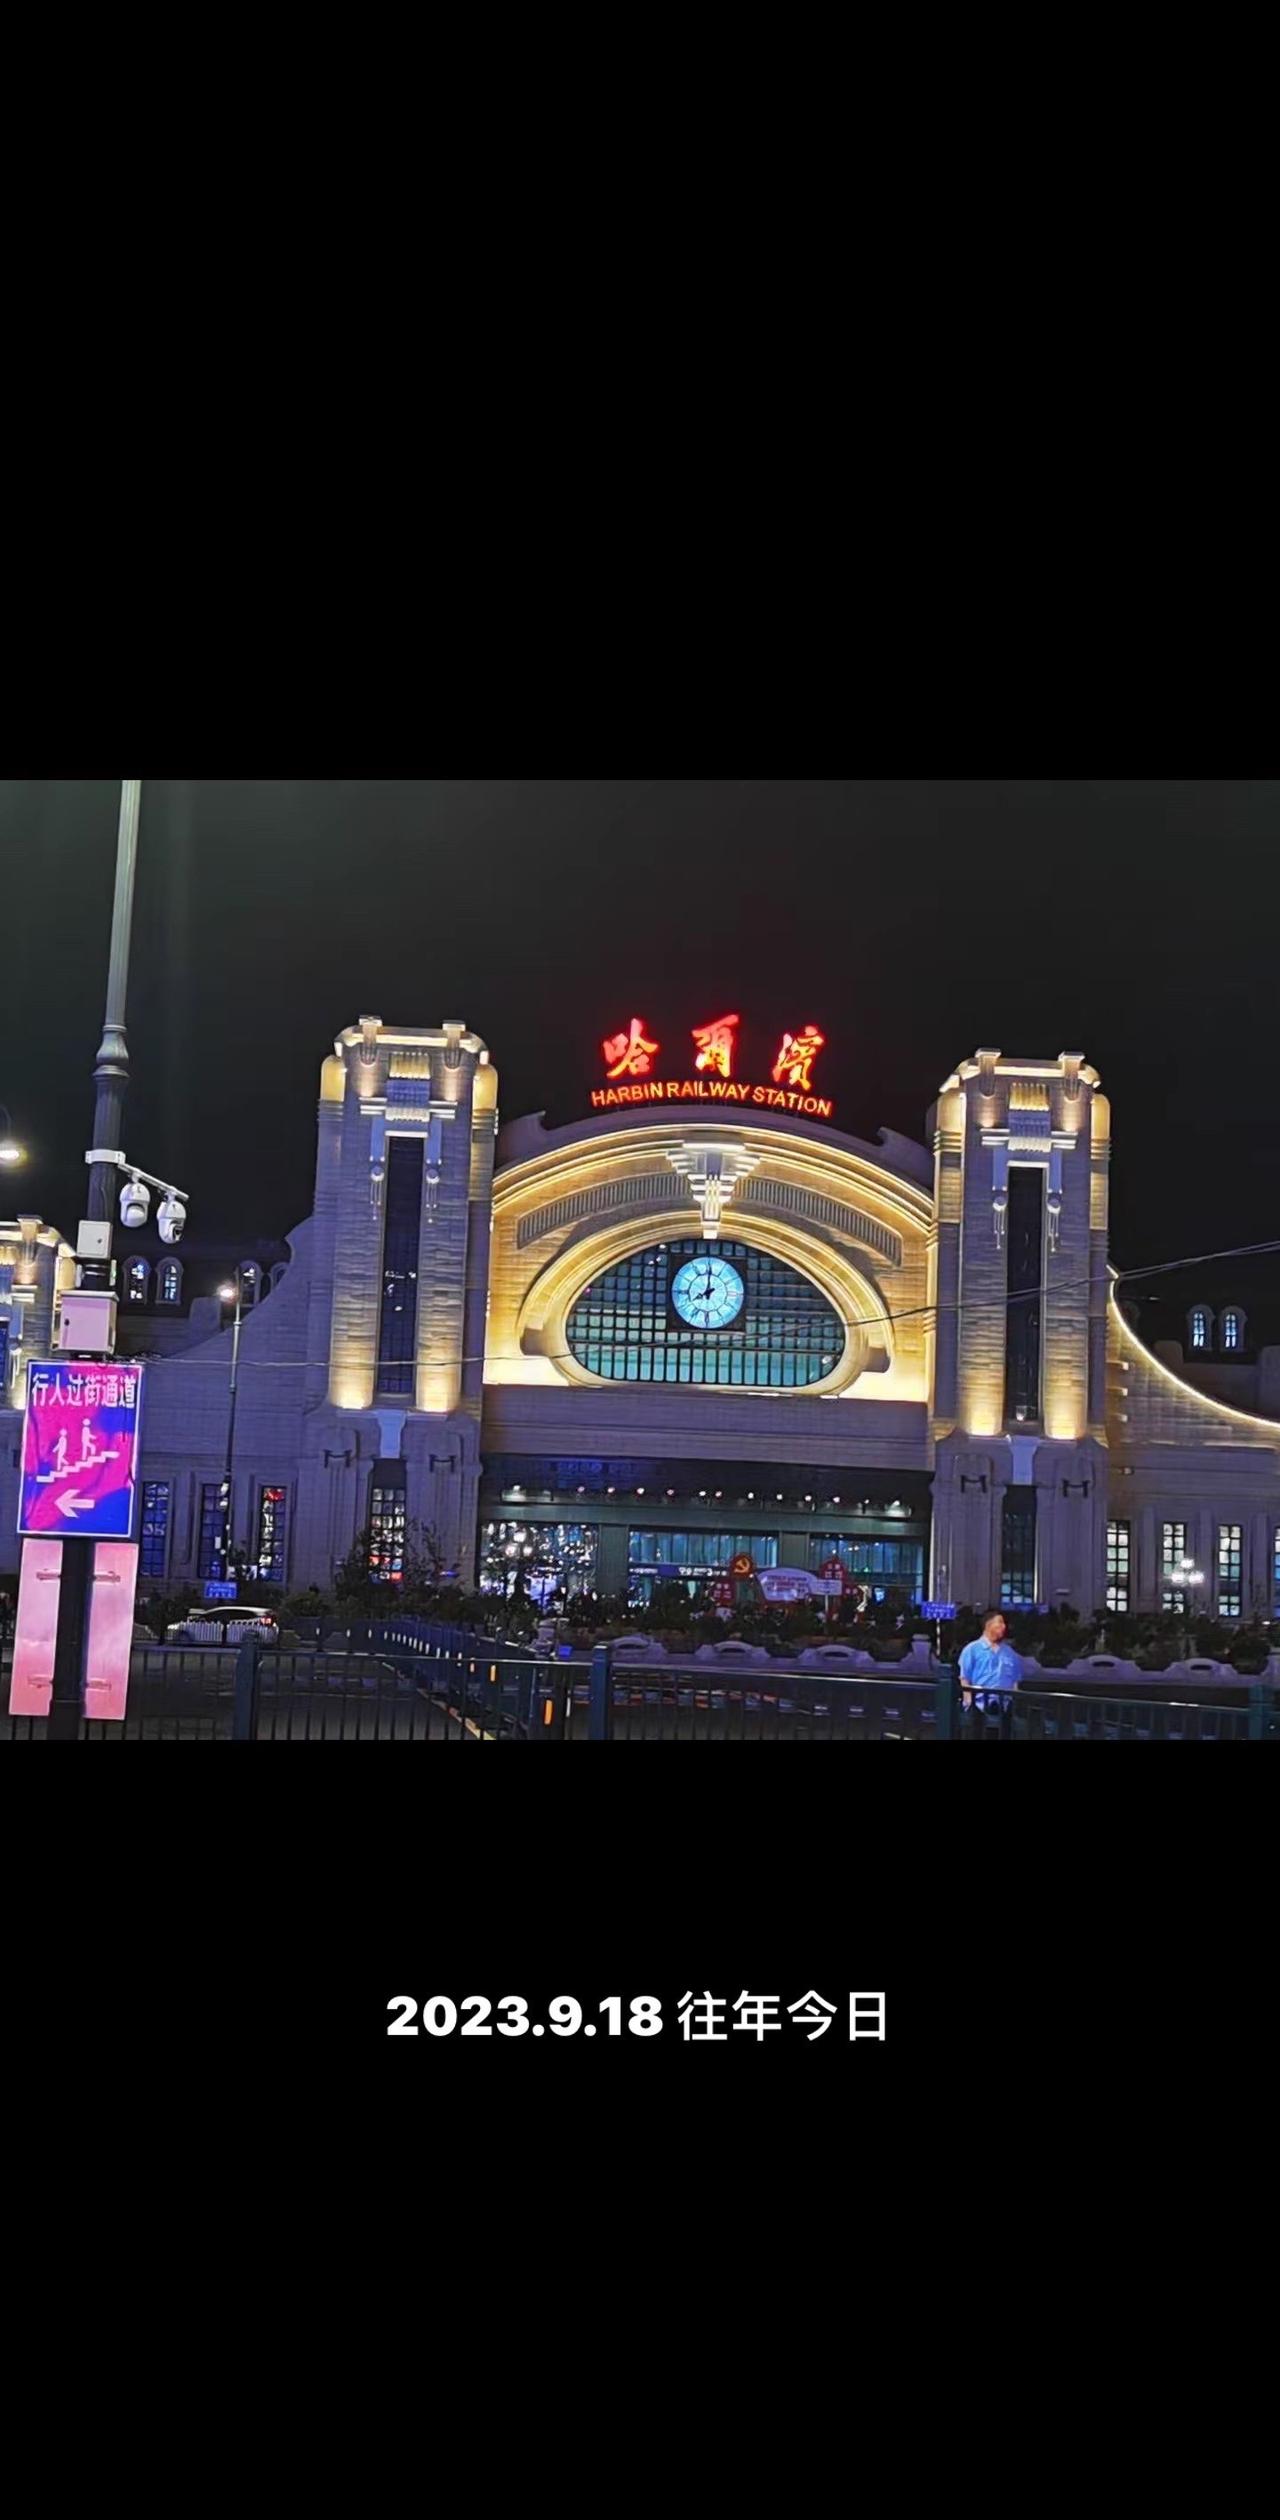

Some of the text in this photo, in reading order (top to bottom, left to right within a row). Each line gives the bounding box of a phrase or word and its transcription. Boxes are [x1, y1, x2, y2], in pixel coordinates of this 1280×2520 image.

[591, 1080, 832, 1117] HARBIN RAILWAY STATION
[32, 1372, 137, 1409] 行人过街通道
